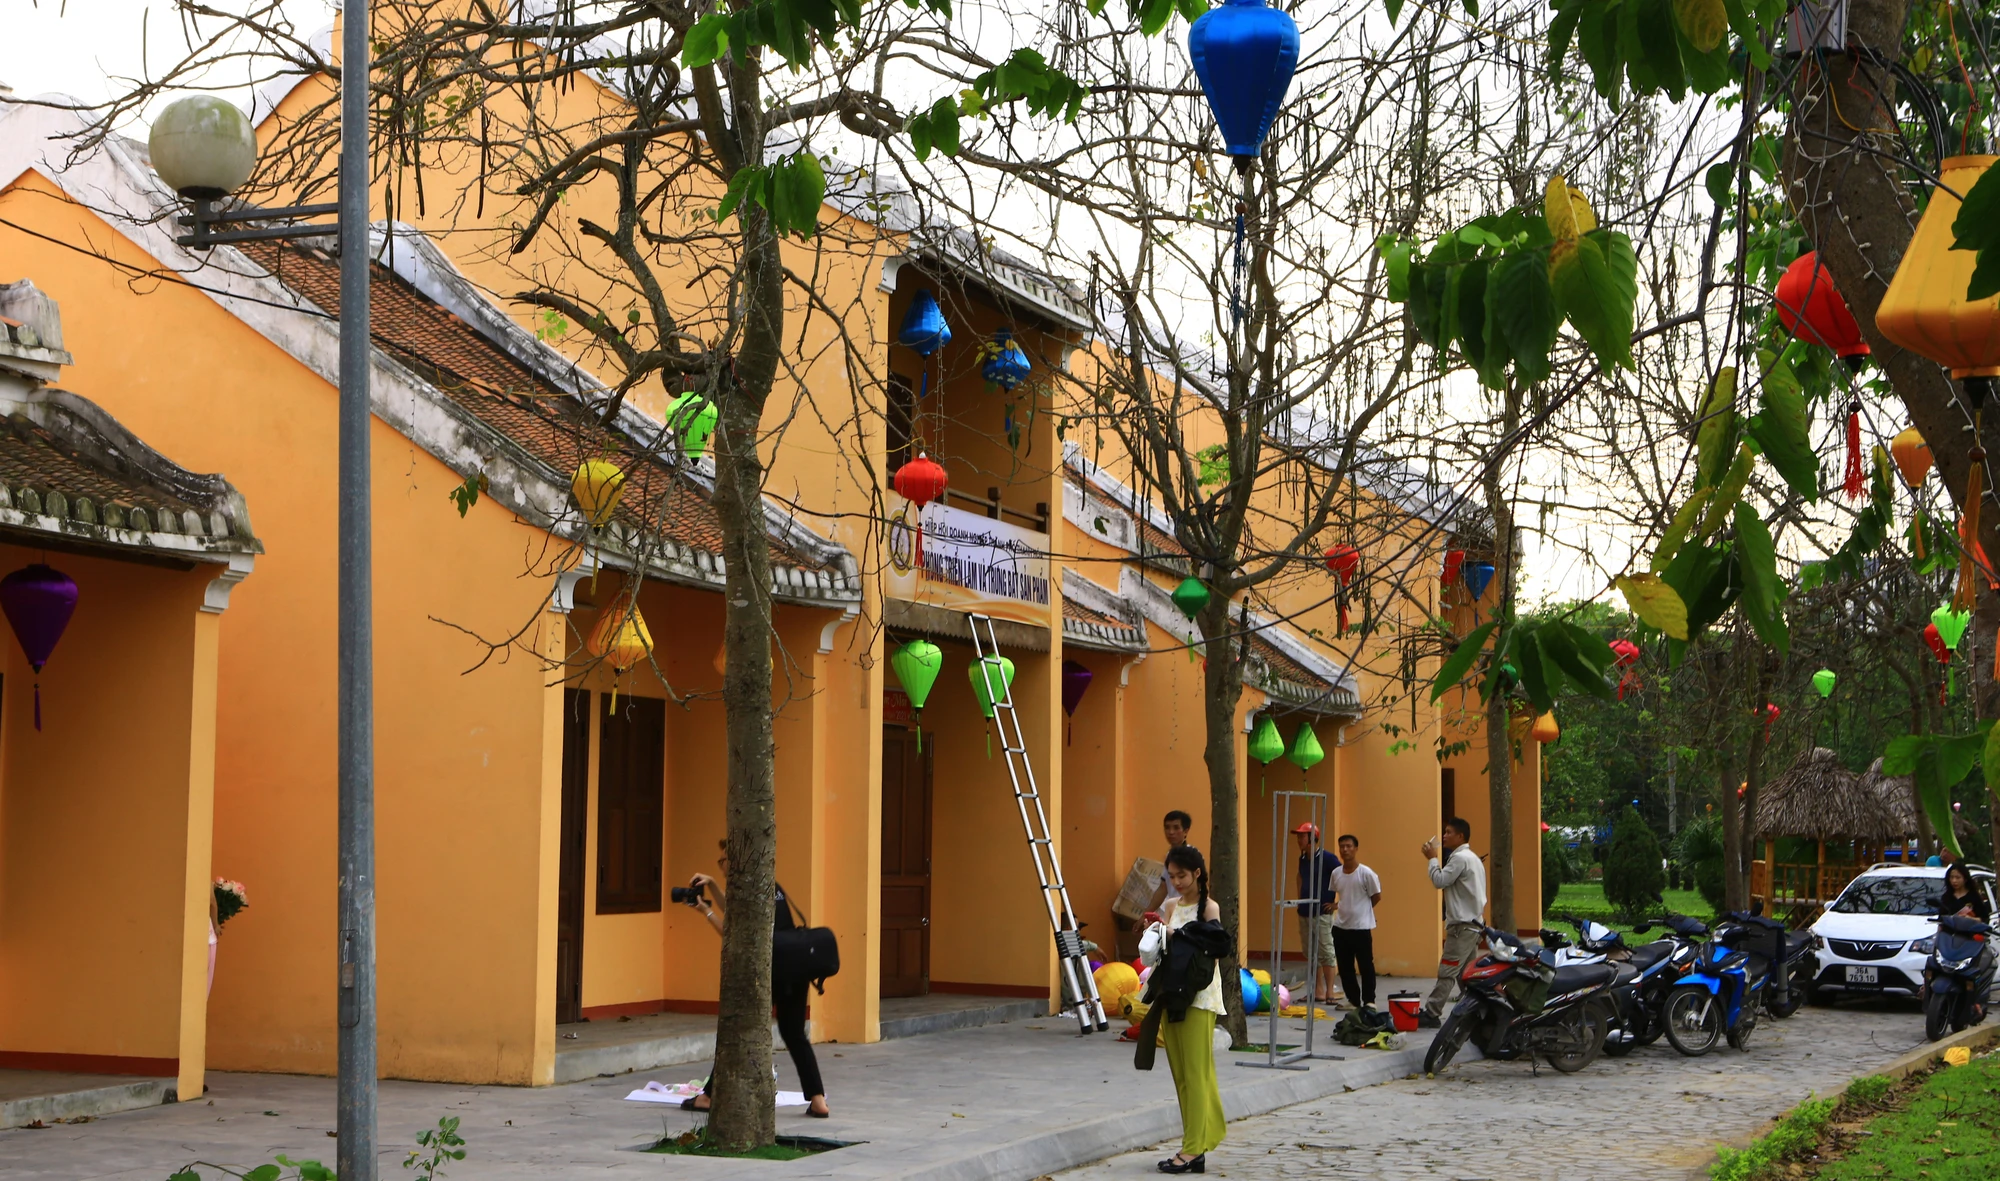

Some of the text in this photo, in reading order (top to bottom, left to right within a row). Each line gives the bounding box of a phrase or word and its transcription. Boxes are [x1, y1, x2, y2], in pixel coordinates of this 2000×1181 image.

[950, 527, 968, 540] DOANH
[964, 555, 978, 591] LÃM
[978, 558, 987, 592] VÀ
[1020, 564, 1032, 602] SẢN
[1032, 566, 1049, 605] PHẨM
